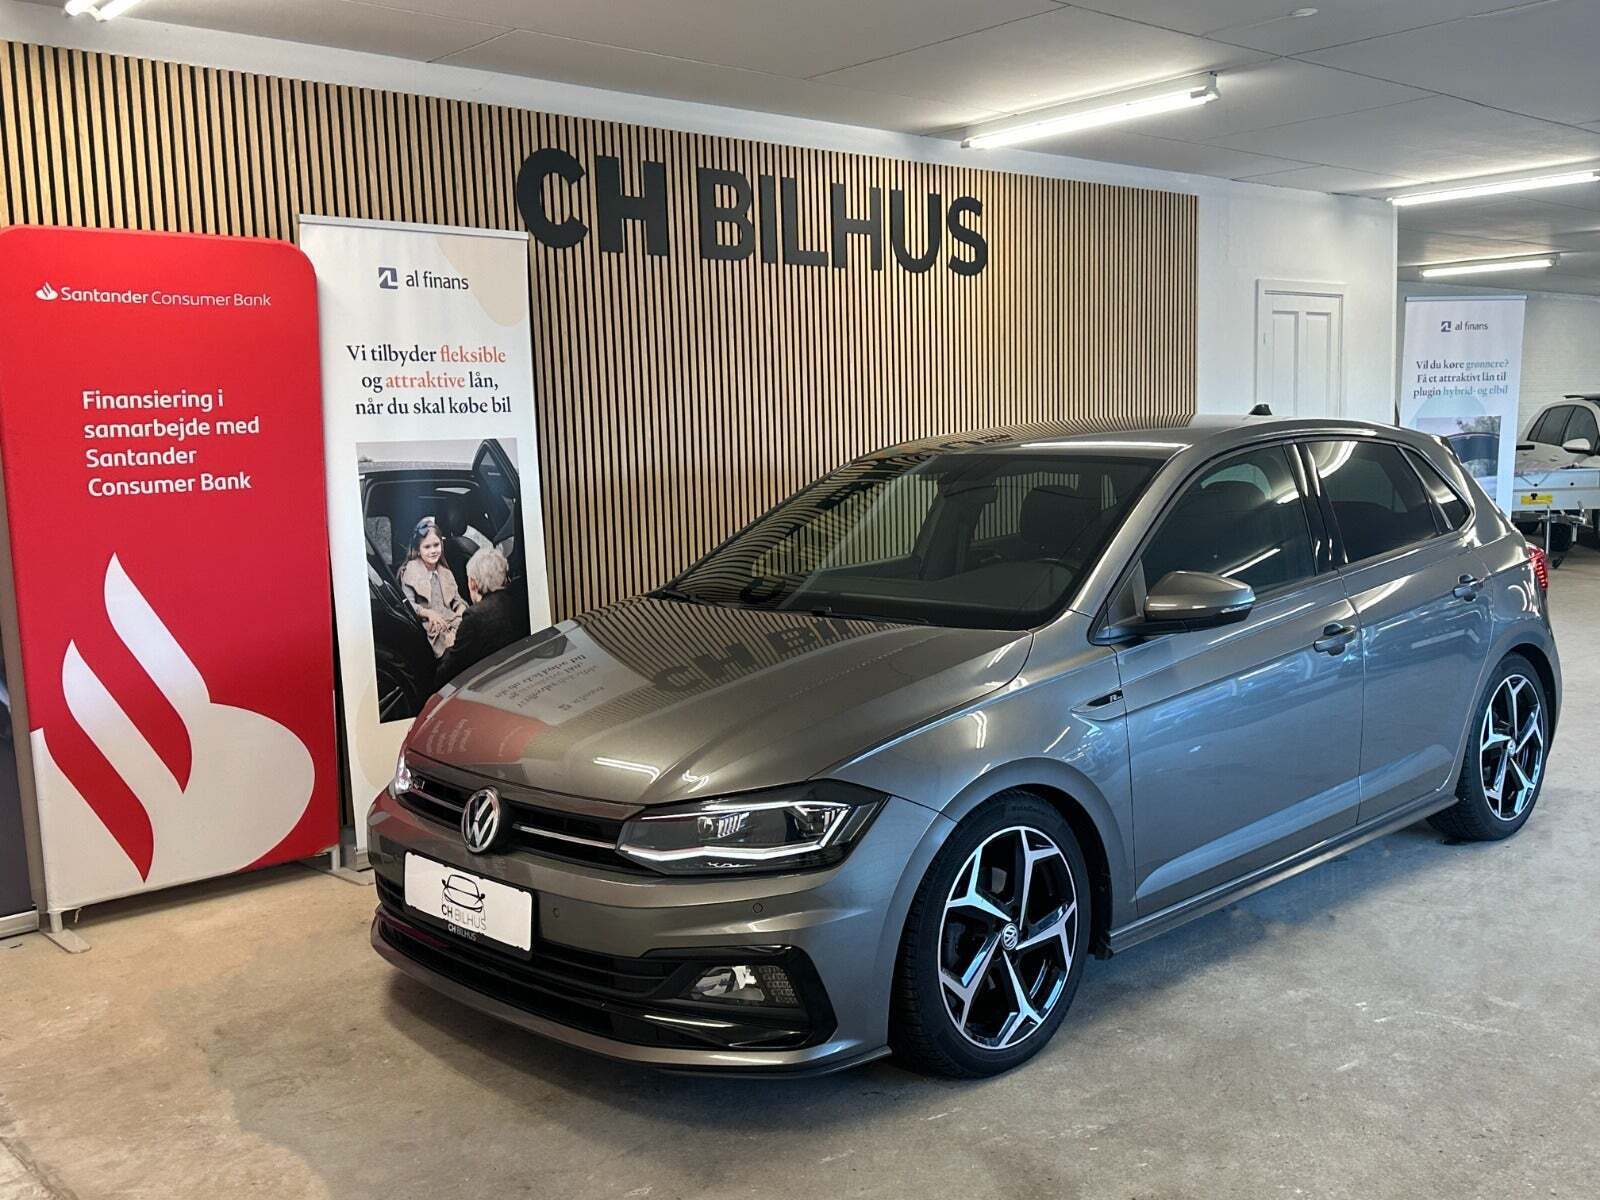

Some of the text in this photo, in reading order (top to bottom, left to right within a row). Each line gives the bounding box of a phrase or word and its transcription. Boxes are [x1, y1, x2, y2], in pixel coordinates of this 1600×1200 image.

[516, 147, 989, 277] CH BILHUS
[405, 270, 470, 290] al finans
[60, 286, 272, 307] Santander Consumer Bank
[1454, 321, 1489, 331] al finans
[346, 344, 507, 366] Vi tilbyder fleksible
[1430, 359, 1442, 369] du
[361, 371, 500, 393] og attraktive lån,
[1439, 371, 1481, 383] attraktivt
[82, 388, 225, 413] Finansiering i
[355, 396, 513, 415] når du skal købe bil
[83, 415, 261, 442] samarbejde med
[85, 446, 198, 469] Santander
[87, 471, 253, 498] Consumer Bank
[441, 904, 487, 930] CH BILHUS
